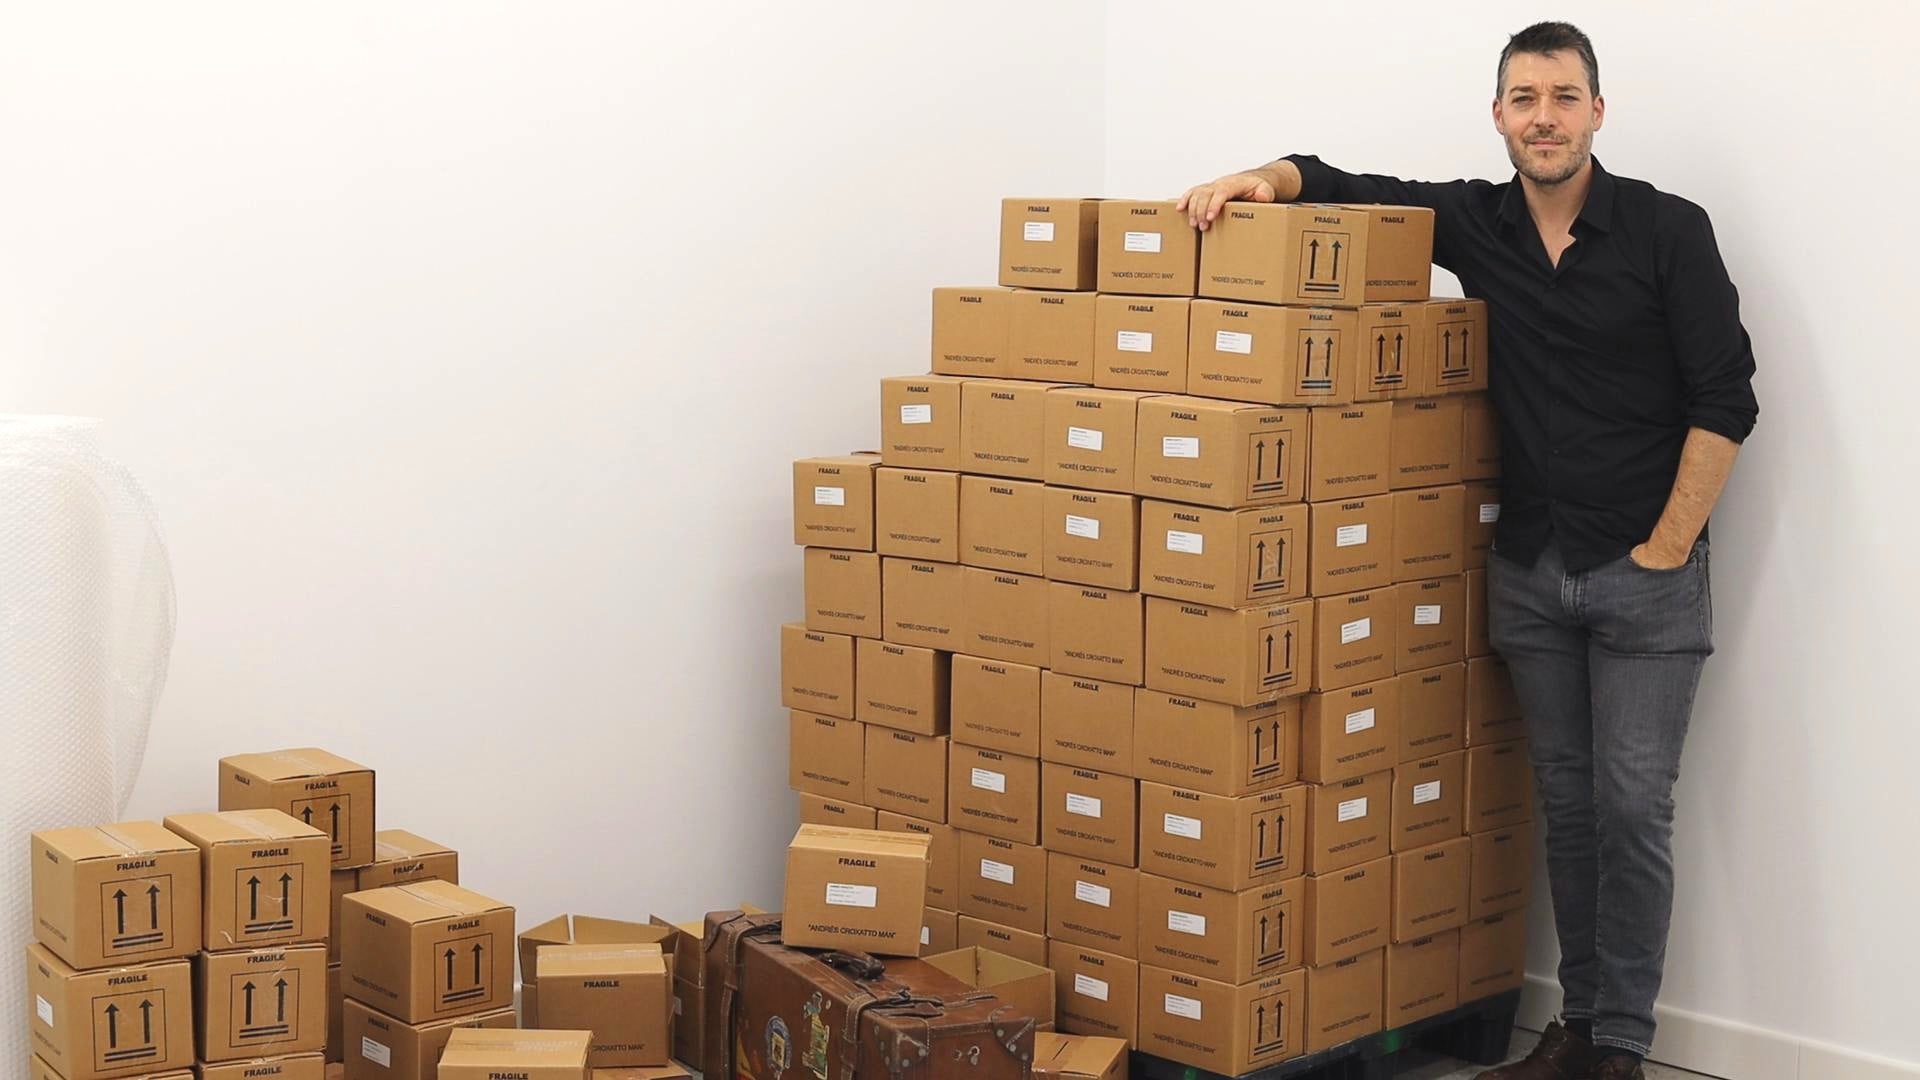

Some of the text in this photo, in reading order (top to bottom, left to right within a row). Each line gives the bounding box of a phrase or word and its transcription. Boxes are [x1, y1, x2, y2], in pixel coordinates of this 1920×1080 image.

[1314, 216, 1341, 224] FRAGILE
[1381, 216, 1405, 224] FRAGILE
[1222, 309, 1248, 317] FRAGILE
[991, 392, 1015, 400] FRAGILE
[1171, 412, 1197, 421] FRAGILE
[1259, 416, 1283, 424] FRAGILE
[1341, 411, 1363, 419] FRAGILE
[904, 475, 926, 483] FRAGILE
[990, 486, 1013, 495] FRAGILE
[1072, 494, 1096, 503] FRAGILE
[1342, 501, 1364, 511] FRAGILE
[1173, 513, 1200, 522] FRAGILE
[1259, 515, 1283, 524] FRAGILE
[830, 553, 850, 561] FRAGILE
[911, 565, 934, 573] FRAGILE
[994, 576, 1019, 585] FRAGILE
[1082, 590, 1107, 599] FRAGILE
[1348, 594, 1369, 605] FRAGILE
[1181, 606, 1208, 617] FRAGILE
[805, 633, 824, 642] FRAGILE
[883, 645, 904, 655] FRAGILE
[981, 665, 1006, 674] FRAGILE
[1073, 681, 1099, 692] FRAGILE
[1351, 688, 1373, 698] FRAGILE
[1169, 697, 1196, 708] FRAGILE
[816, 718, 835, 727] FRAGILE
[893, 733, 915, 743] FRAGILE
[978, 751, 1002, 761] FRAGILE
[1073, 770, 1098, 780] FRAGILE
[305, 780, 338, 790] FRAGILE
[1173, 790, 1200, 801] FRAGILE
[824, 804, 845, 814] FRAGILE
[906, 823, 930, 834] FRAGILE
[988, 839, 1012, 849] FRAGILE
[251, 848, 289, 859] FRAGILE
[117, 859, 156, 872] FRAGILE
[838, 858, 876, 868] FRAGILE
[1080, 864, 1106, 876] FRAGILE
[1175, 887, 1202, 899] FRAGILE
[448, 919, 480, 932] FRAGILE
[840, 927, 877, 937] CROXATTO
[987, 930, 1010, 941] FRAGILE
[247, 953, 285, 964] FRAGILE
[1080, 954, 1104, 966] FRAGILE
[108, 974, 148, 986] FRAGILE
[1172, 975, 1198, 987] FRAGILE
[244, 1066, 282, 1077] FRAGILE
[489, 1072, 528, 1080] FRAGILE
